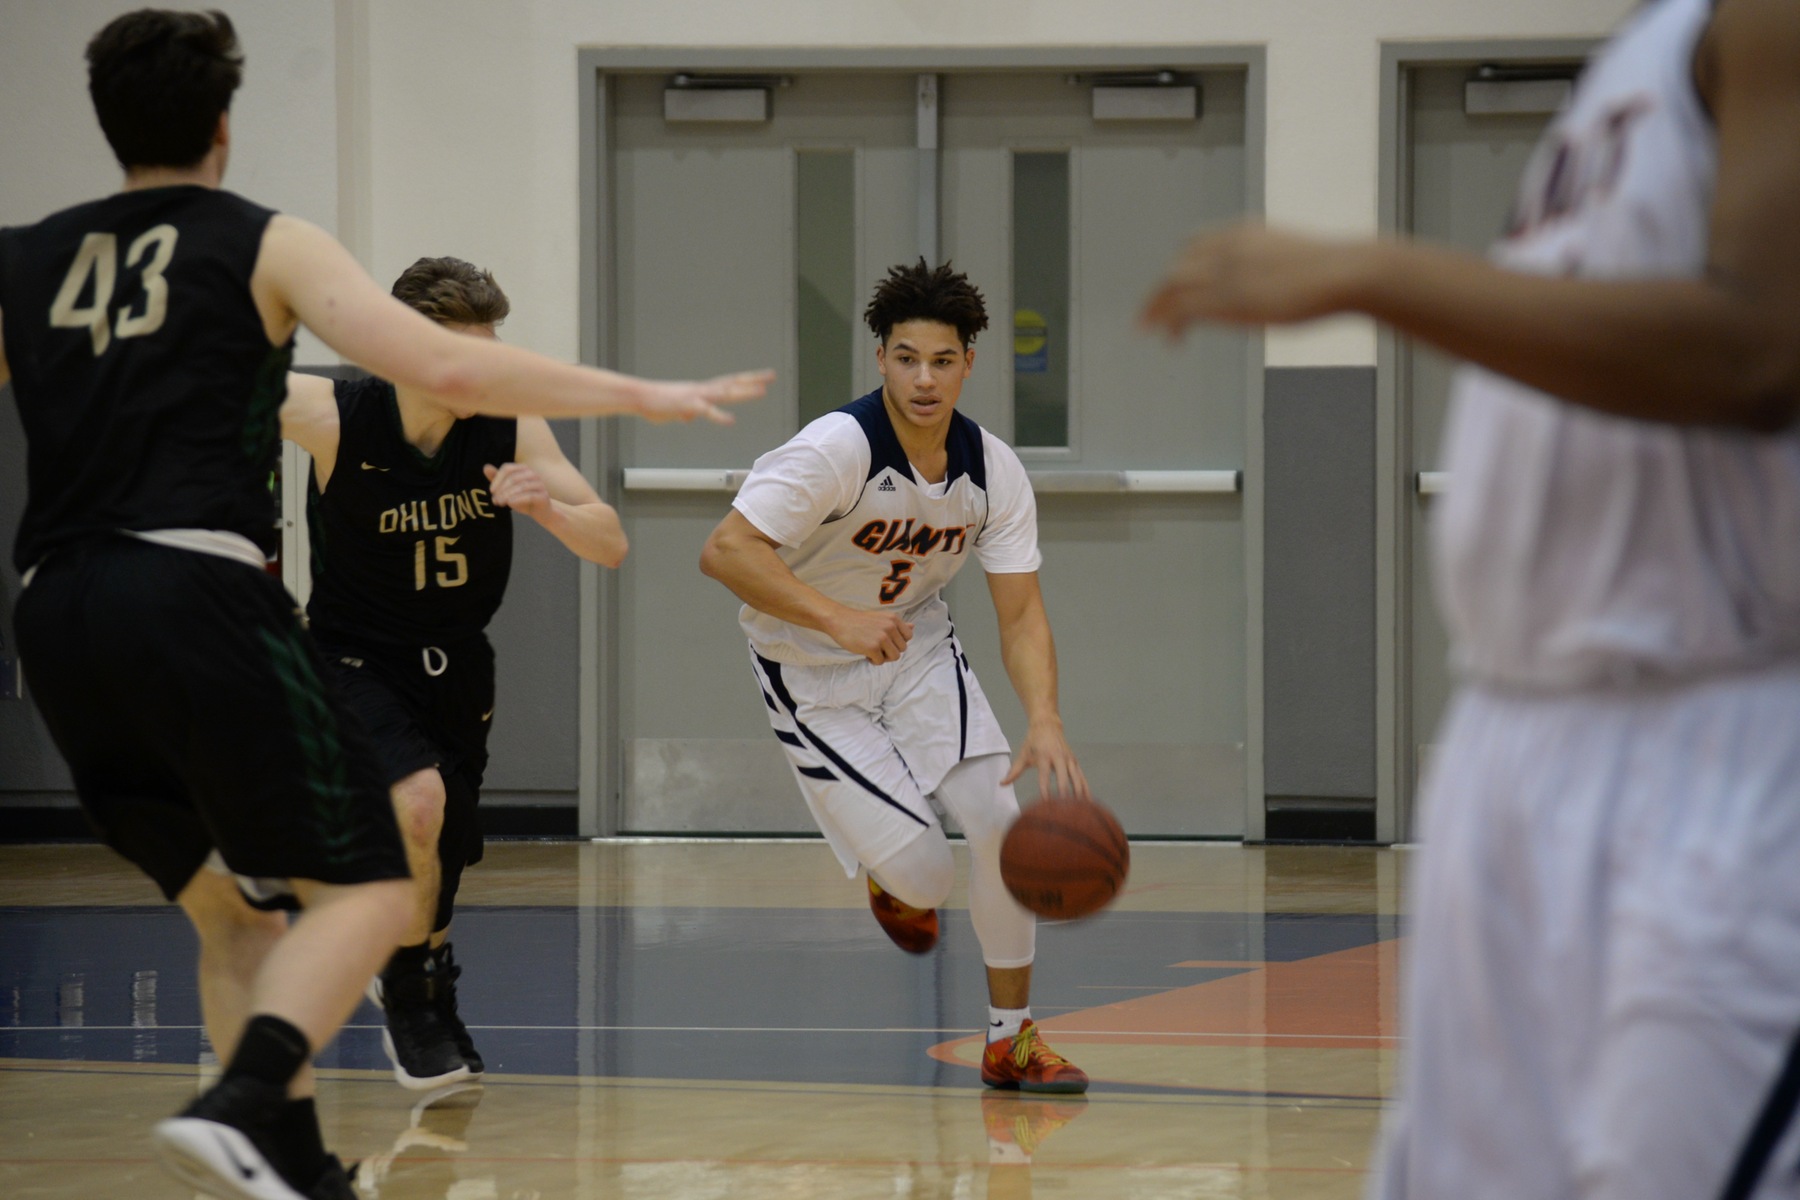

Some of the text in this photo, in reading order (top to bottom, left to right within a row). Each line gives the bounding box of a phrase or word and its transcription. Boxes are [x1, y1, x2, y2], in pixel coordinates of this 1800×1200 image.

[49, 223, 179, 357] 43
[379, 488, 495, 533] OHLONE
[415, 535, 468, 591] 15
[878, 559, 916, 605] 5
